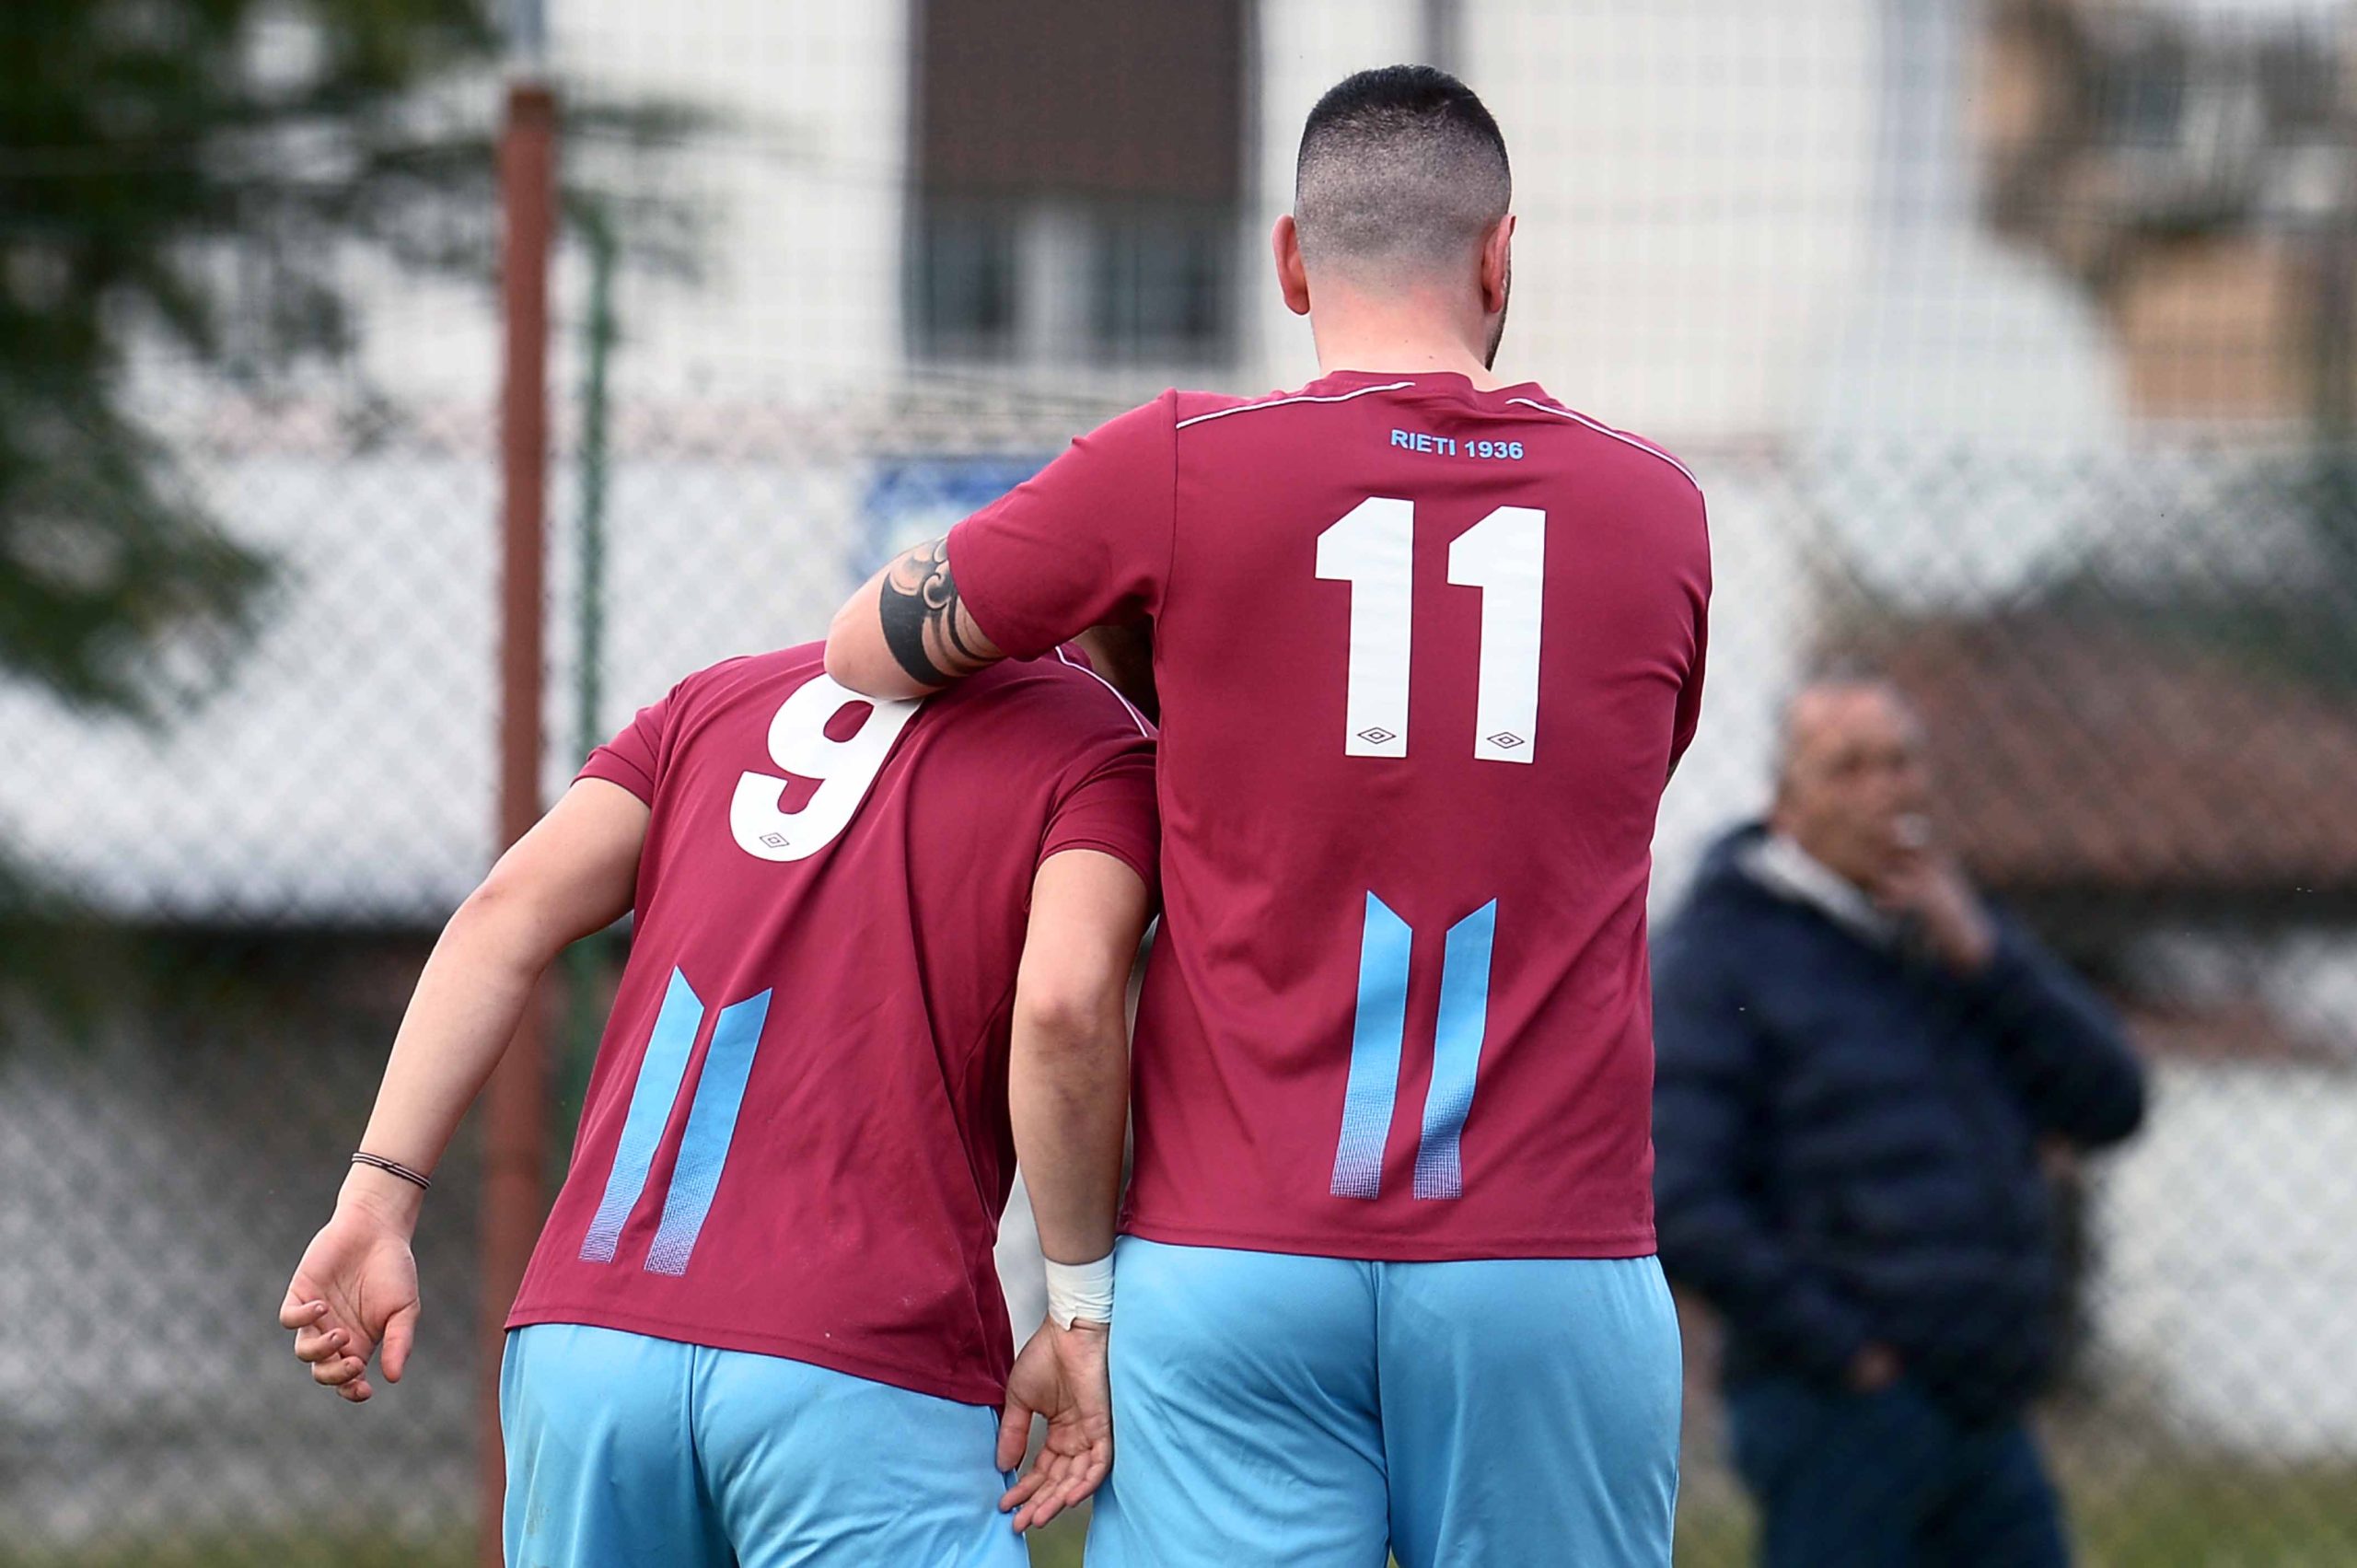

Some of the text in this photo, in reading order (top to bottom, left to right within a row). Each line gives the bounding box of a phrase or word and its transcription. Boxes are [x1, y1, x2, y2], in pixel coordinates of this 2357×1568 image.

[1389, 428, 1525, 459] RIETI 1936
[1315, 495, 1547, 764] 11
[729, 671, 926, 864] 9
